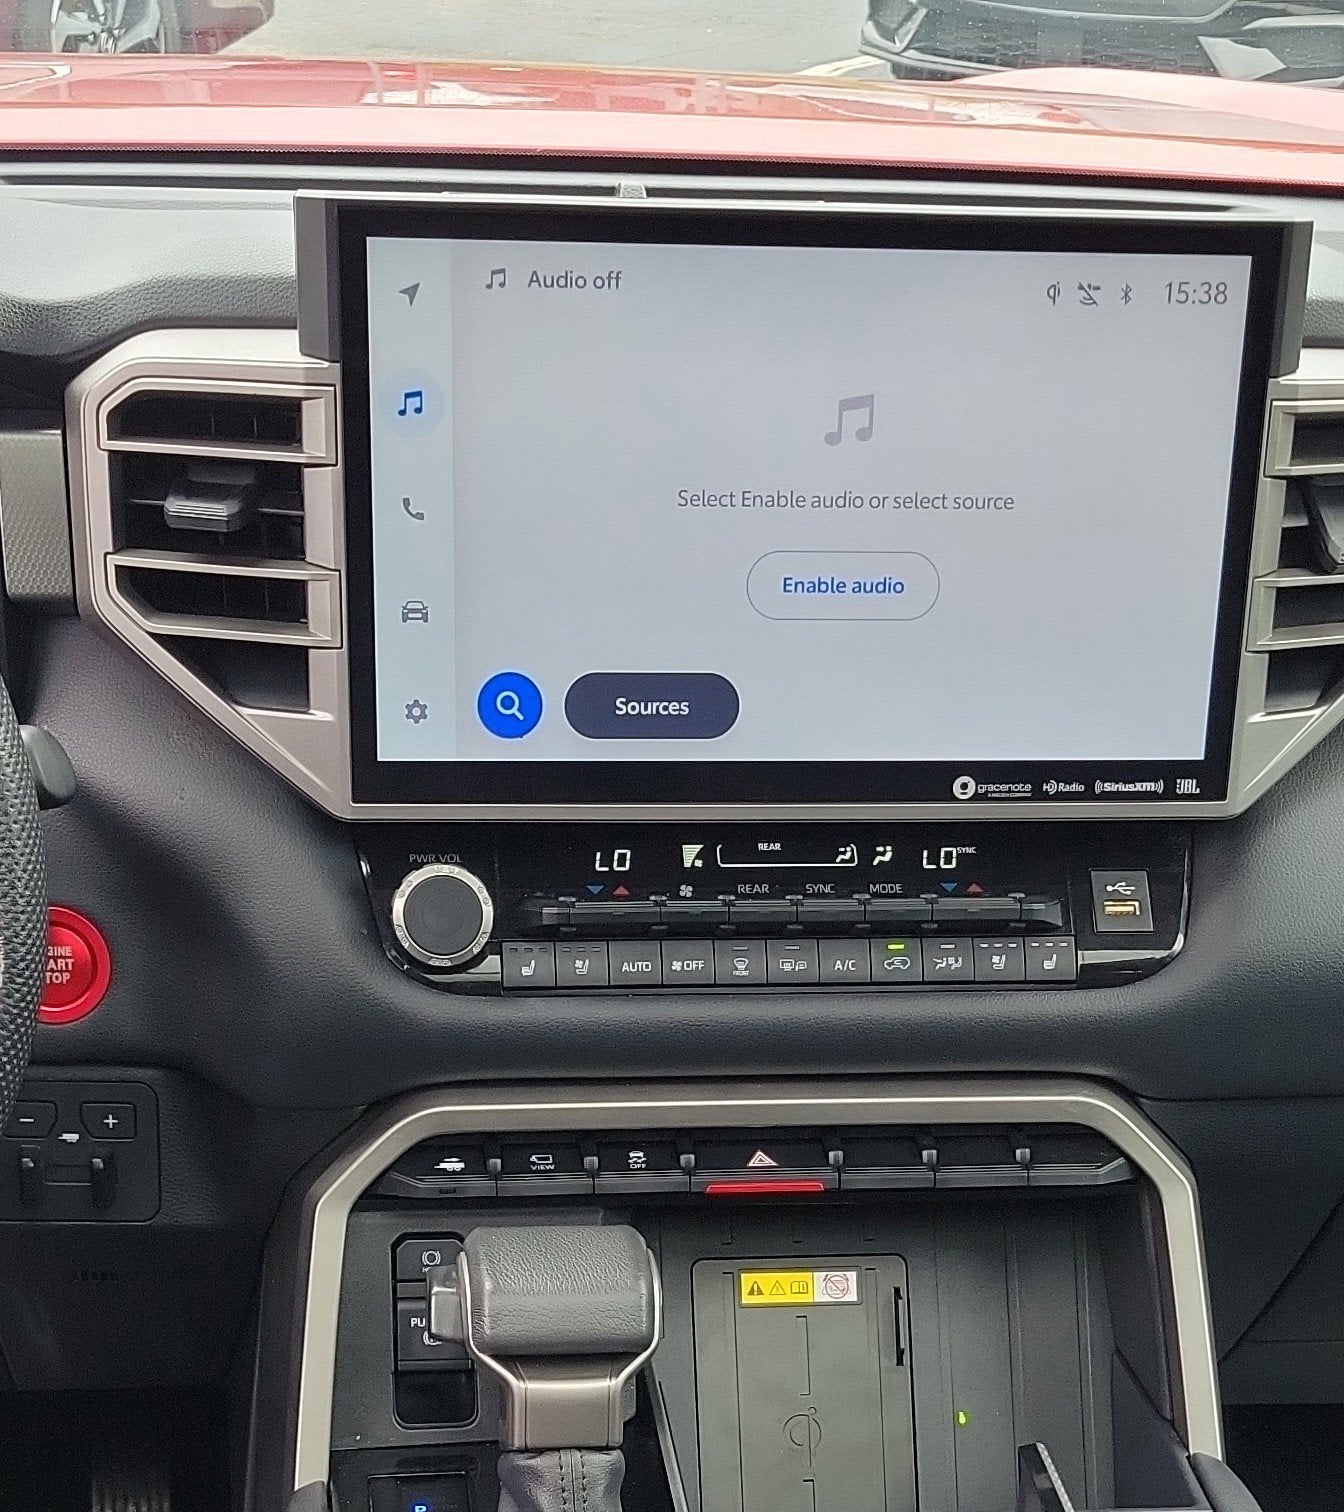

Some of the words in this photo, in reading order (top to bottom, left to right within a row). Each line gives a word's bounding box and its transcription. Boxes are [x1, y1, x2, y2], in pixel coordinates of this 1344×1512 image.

[527, 270, 588, 289] Audio
[593, 270, 623, 289] off
[1164, 281, 1228, 305] 15:38
[677, 489, 737, 508] Select
[741, 490, 807, 509] Enable
[810, 490, 864, 510] audio
[868, 496, 888, 510] or
[892, 491, 949, 510] select
[953, 495, 1016, 511] source
[782, 577, 847, 594] Enable
[851, 577, 905, 594] audio
[615, 697, 690, 716] Sources
[1176, 779, 1200, 794] JBL
[757, 843, 781, 851] REAR
[409, 853, 436, 863] PWR
[438, 853, 463, 863] VOL
[737, 884, 770, 894] REAR
[805, 883, 836, 894] SYNC
[869, 883, 903, 894] MODE
[46, 958, 75, 971] ART
[621, 961, 652, 973] AUTO
[683, 960, 705, 971] OFF
[834, 959, 857, 972] A/C
[45, 972, 71, 984] TOP
[410, 1317, 426, 1328] PU
